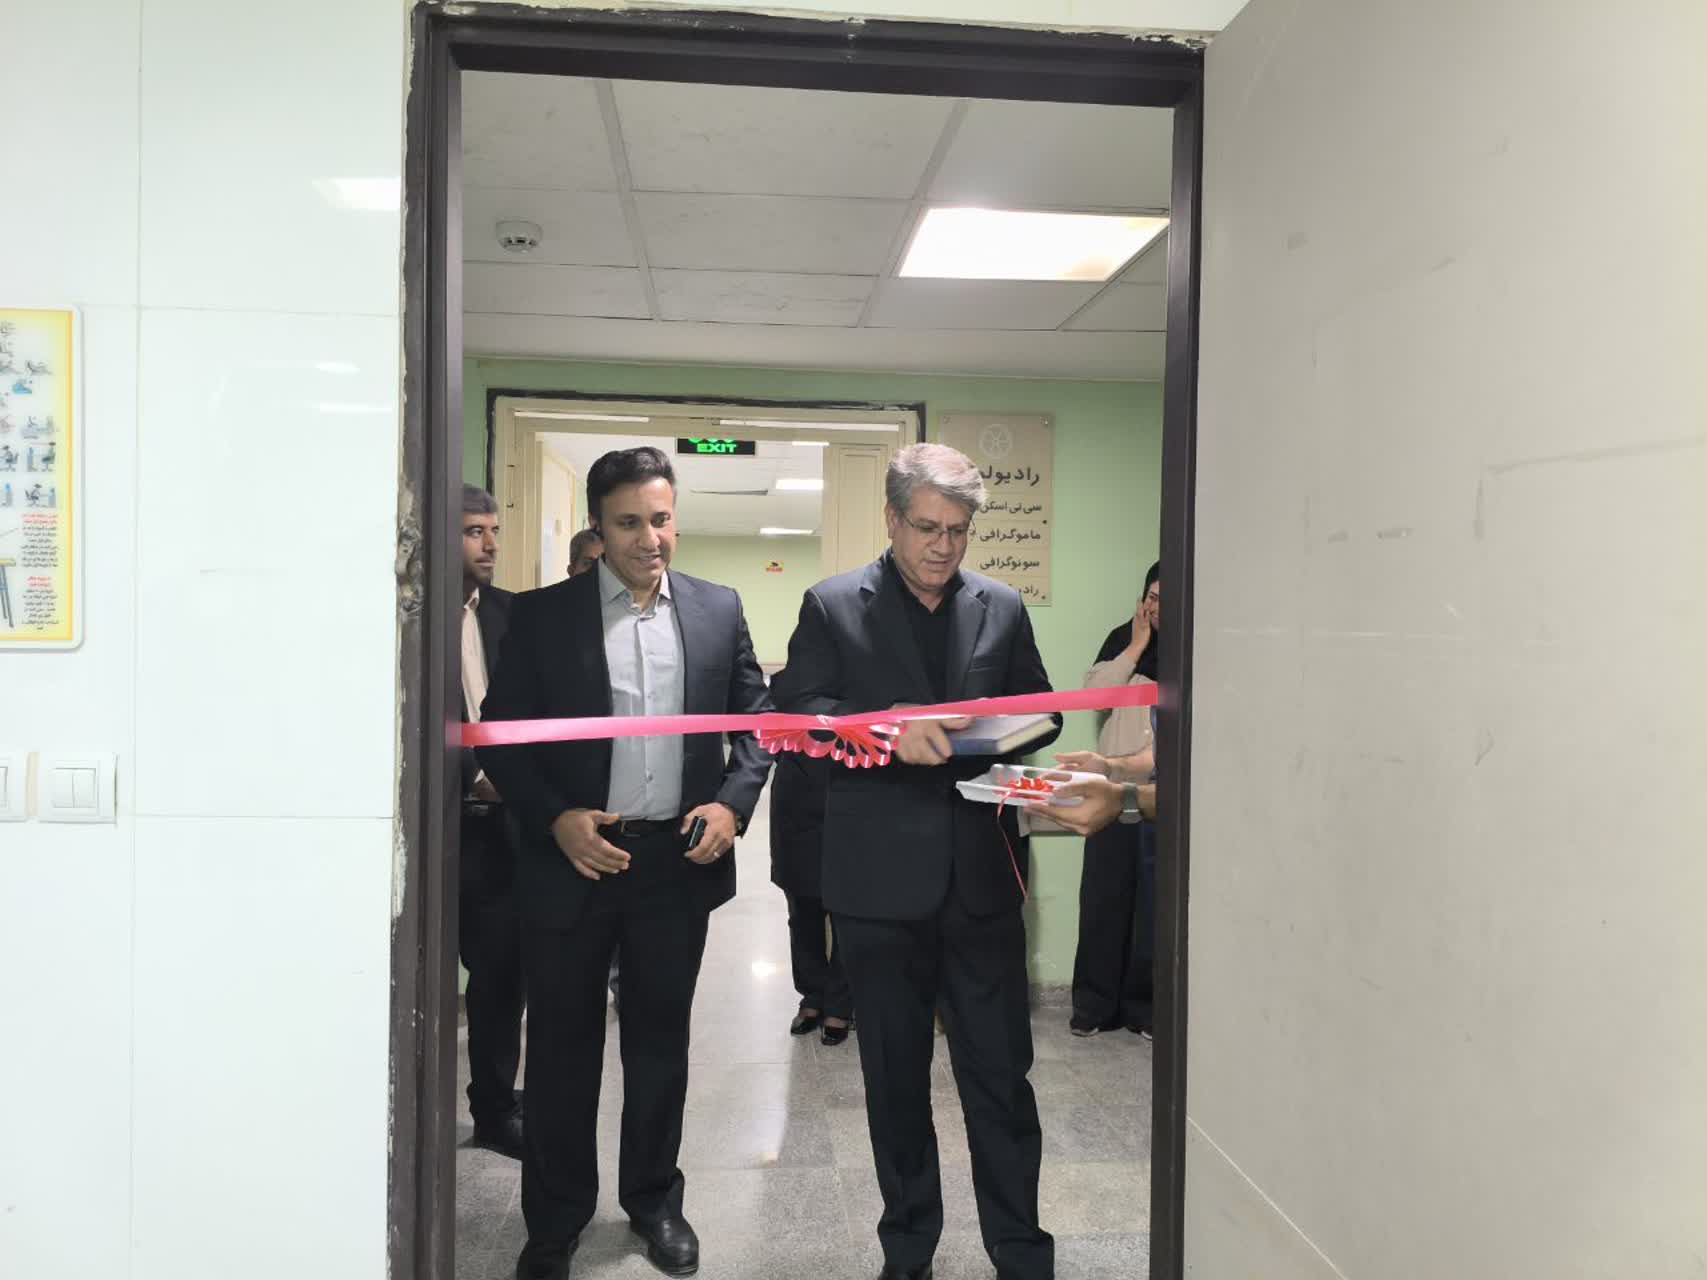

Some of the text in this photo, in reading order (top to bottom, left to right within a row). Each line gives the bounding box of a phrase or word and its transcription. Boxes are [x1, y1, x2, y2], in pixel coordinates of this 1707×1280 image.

[697, 443, 737, 453] EXIT
[979, 464, 1040, 487] رادیول
[980, 528, 1041, 543] ماموگرافی
[980, 556, 1040, 571] سونوگرافی
